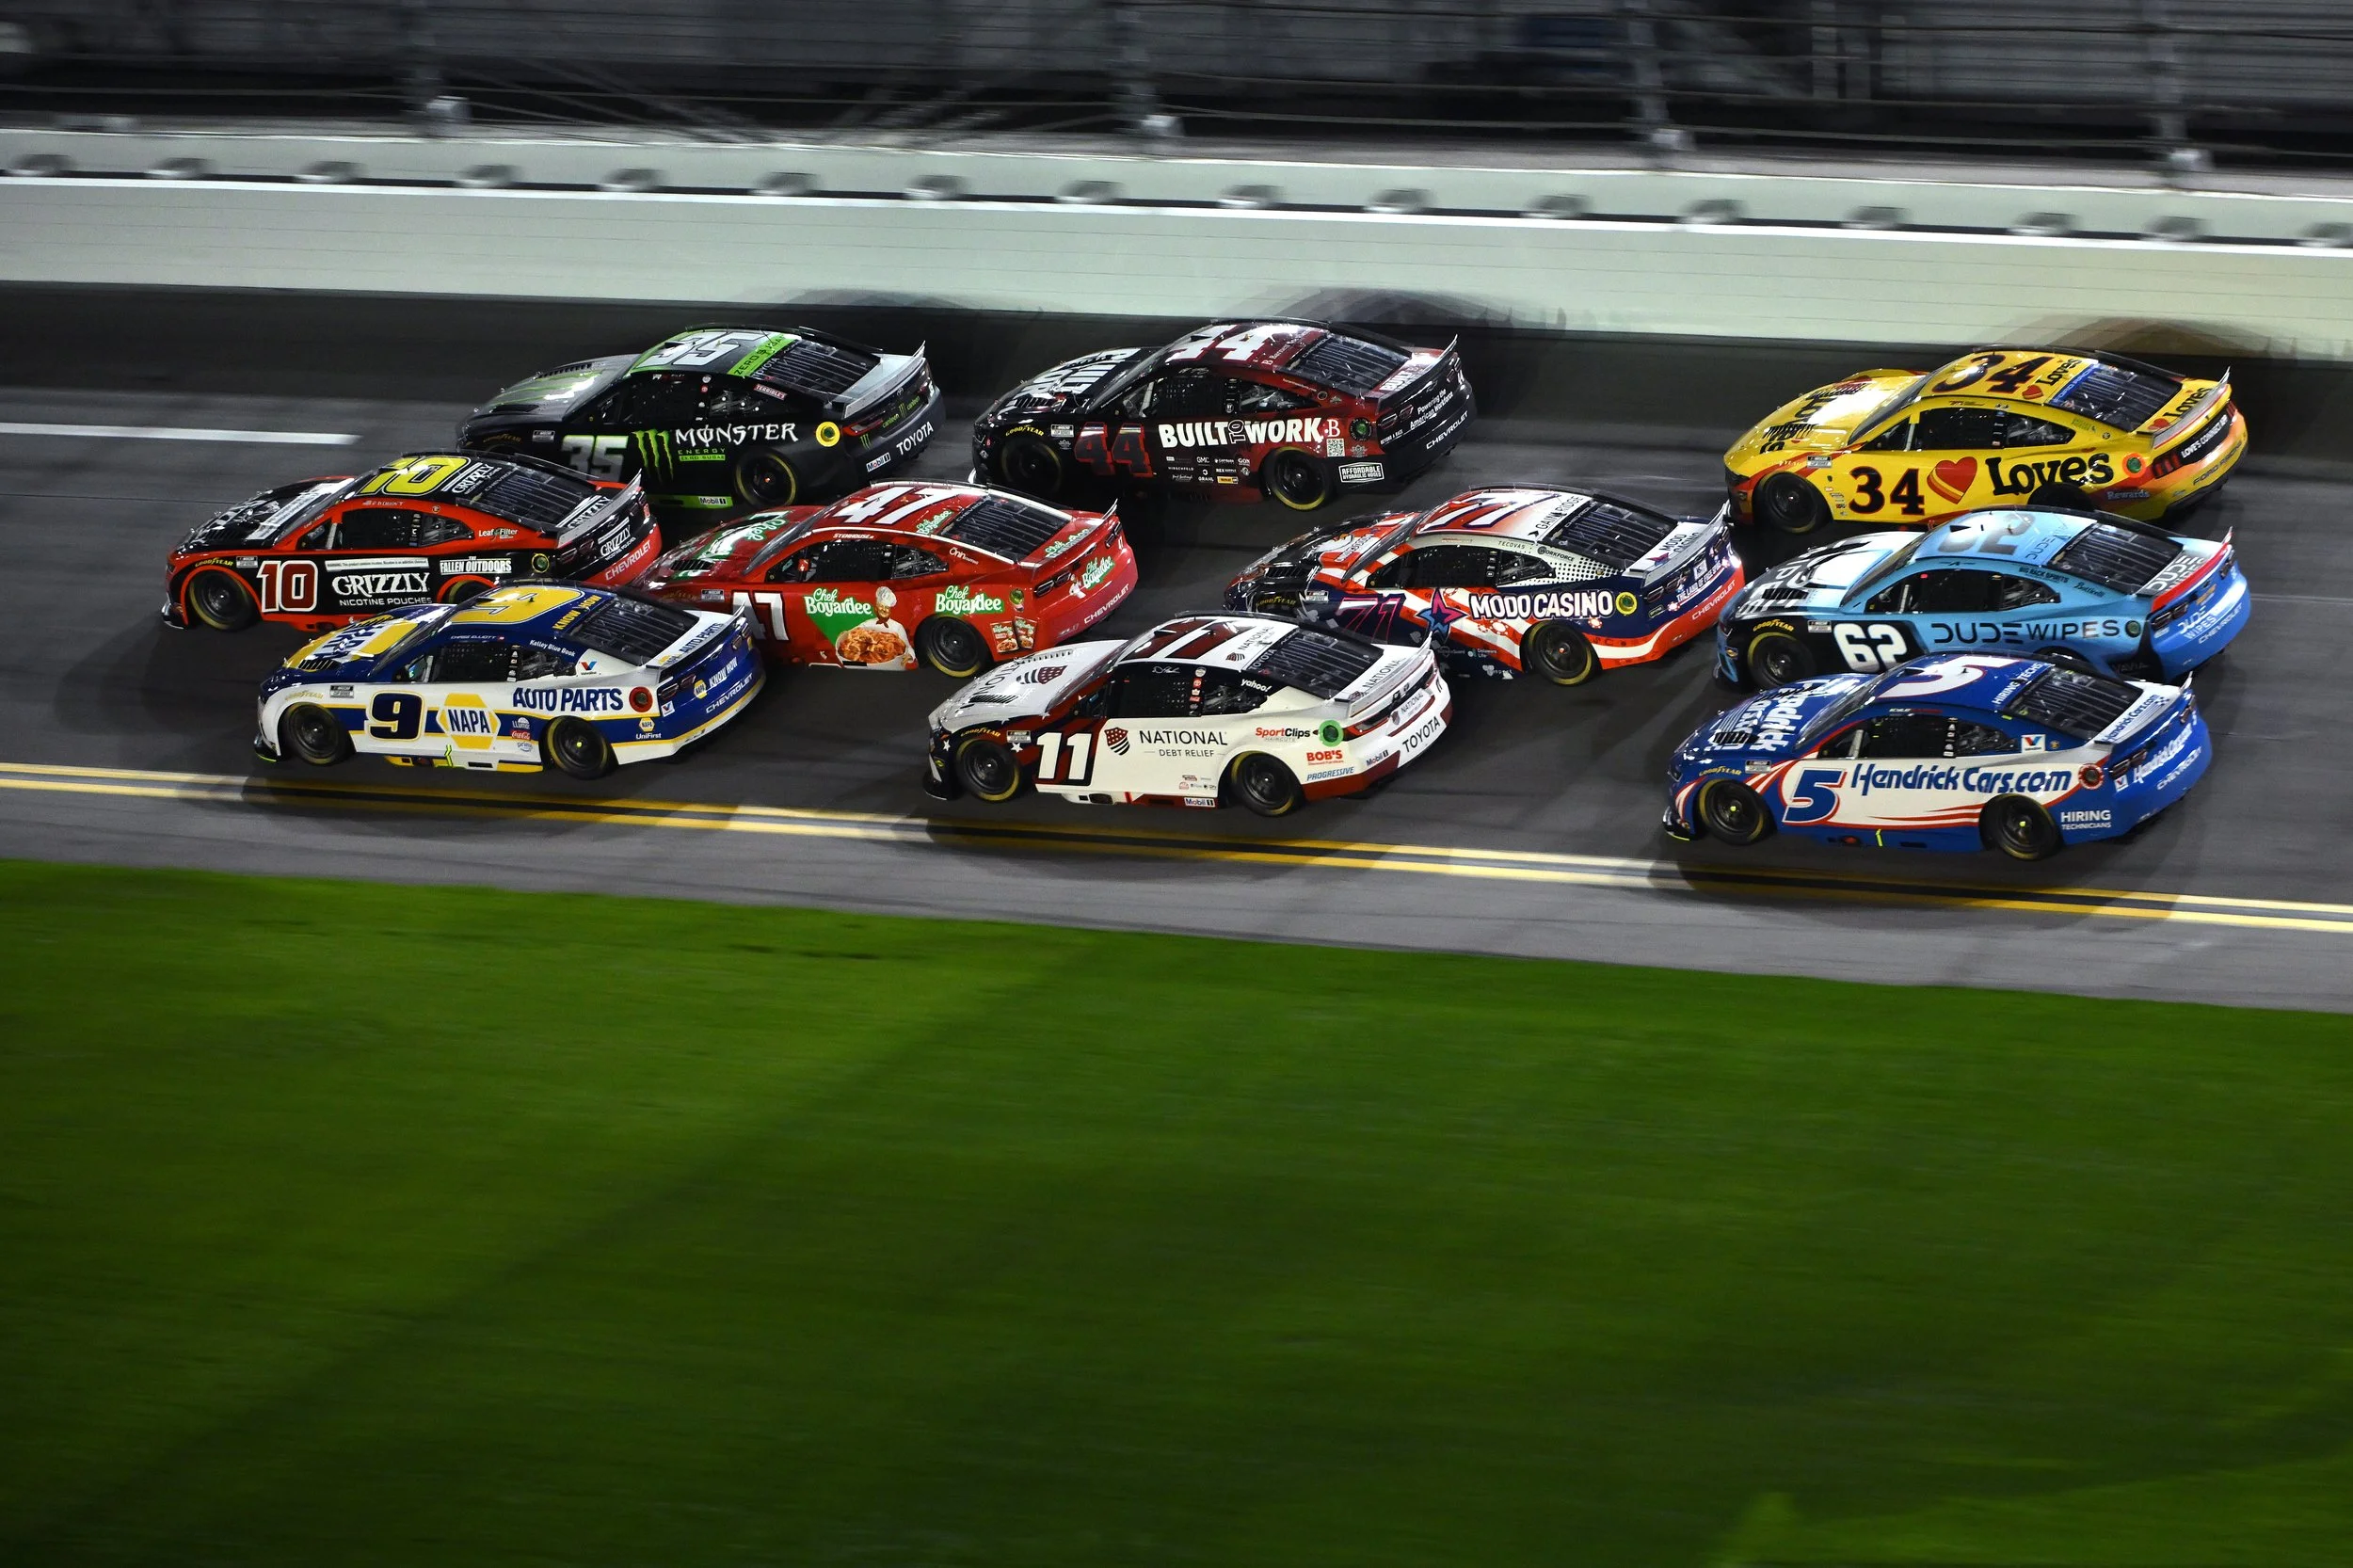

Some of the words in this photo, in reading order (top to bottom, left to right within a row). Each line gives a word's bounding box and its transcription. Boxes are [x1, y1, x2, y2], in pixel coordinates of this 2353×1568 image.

[1417, 393, 1442, 415] Powering
[1410, 407, 1436, 431] American
[1426, 410, 1468, 450] CHEVROLET
[896, 421, 934, 456] TOYOTA
[1005, 424, 1045, 437] GOODYEAR
[1158, 421, 1228, 448] BUILT
[1228, 420, 1245, 444] TO
[1244, 418, 1324, 444] WORK
[562, 433, 629, 483] 35
[1075, 421, 1155, 478] 44
[2181, 440, 2201, 458] LOVE'S
[867, 457, 885, 472] Mobil
[1341, 465, 1381, 474] AFFORDABLE
[1849, 466, 1925, 516] 34
[2106, 488, 2151, 501] Rewards
[833, 485, 963, 525] 47
[600, 524, 632, 557] GRIZZLY
[1498, 540, 1526, 549] TECOVAS
[1659, 534, 1687, 552] MODO
[195, 556, 234, 568] GOODYEAR
[440, 561, 465, 573] FALLEN
[465, 560, 512, 572] OUTDOORS
[605, 539, 651, 581] CHEVROLET
[257, 560, 318, 613] 10
[332, 572, 430, 598] GRIZZLY
[813, 587, 838, 604] Chef
[945, 584, 970, 600] Chef
[339, 598, 385, 607] NICOTINE
[387, 597, 433, 605] POUCHES
[804, 596, 873, 616] Boyardee
[936, 591, 1003, 616] Boyardee
[1084, 584, 1129, 624] CHEVROLET
[1469, 594, 1533, 619] MODO
[1533, 590, 1615, 618] CASINO
[1691, 579, 1737, 620] CHEVROLET
[552, 609, 582, 631] KNOW
[1753, 618, 1795, 632] GOODYEAR
[2184, 614, 2217, 640] WIPES
[1931, 622, 2023, 644] DUDE
[2025, 619, 2120, 641] WIPES
[529, 639, 548, 650] Kelley
[548, 643, 562, 652] Blue
[561, 647, 576, 657] Book
[1248, 648, 1278, 670] TOYOTA
[1833, 622, 1909, 674] 62
[709, 668, 728, 688] KNOW
[726, 656, 738, 675] HOW
[706, 672, 753, 713] CHEVROLET
[1241, 678, 1273, 692] yahoo!
[1992, 680, 2020, 706] HIRING
[2020, 662, 2042, 684] TECHS
[512, 687, 558, 712] AUTO
[560, 688, 624, 712] PARTS
[366, 690, 424, 742] 9
[447, 708, 491, 733] NAPA
[960, 727, 1001, 737] GOODYEAR
[1139, 730, 1228, 746] NATIONAL
[1401, 716, 1442, 753] TOYOTA
[1037, 731, 1092, 781] 11
[1159, 749, 1184, 758] DEBT
[1186, 749, 1215, 758] RELIEF
[1306, 749, 1343, 762] BOB'S
[1366, 754, 1383, 767] Mobil
[1306, 766, 1354, 781] PROGRESSIVE
[1698, 764, 1742, 776] GOODYEAR
[1186, 797, 1207, 806] Mobil
[1782, 768, 1847, 824] 5
[2059, 809, 2111, 822] HIRING
[2061, 822, 2112, 830] TECHNICIANS
